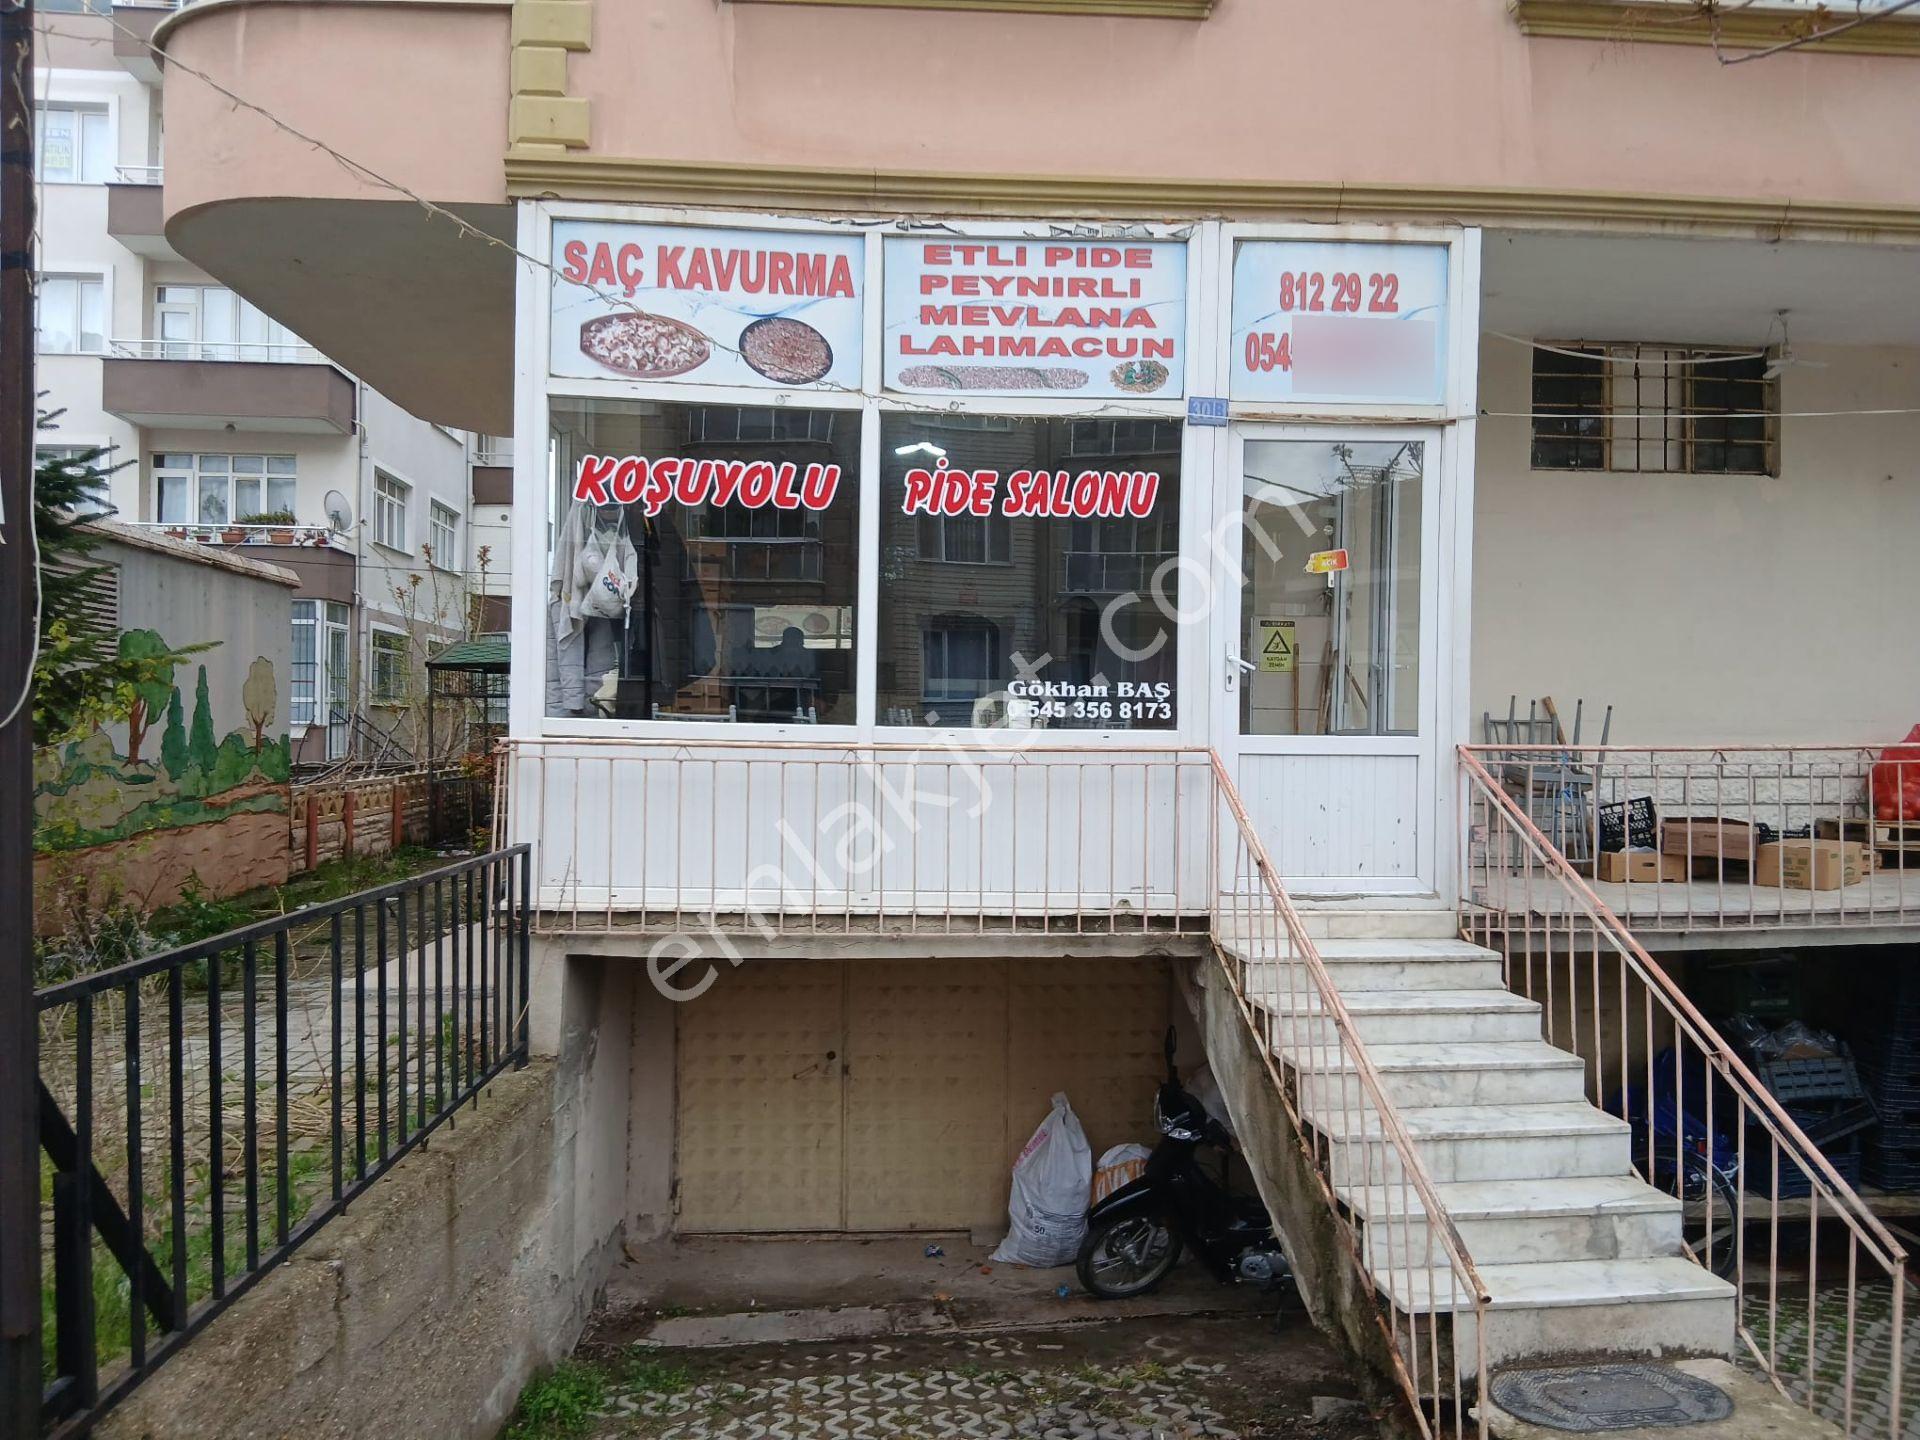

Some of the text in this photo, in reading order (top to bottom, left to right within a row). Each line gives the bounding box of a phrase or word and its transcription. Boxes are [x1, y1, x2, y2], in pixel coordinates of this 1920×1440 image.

[563, 240, 855, 298] SAÇ KAVURMA
[1280, 271, 1399, 312] 812 29 22
[920, 305, 1157, 328] MEVLANA
[900, 335, 1174, 358] LAHMACUN
[1245, 332, 1293, 373] 054
[573, 454, 842, 518] KOŞUYOLU
[903, 457, 1160, 518] PİDE SALONU
[1007, 680, 1171, 702] Gökhan BAŞ
[1073, 701, 1113, 719] 356
[1119, 702, 1172, 719] 8173
